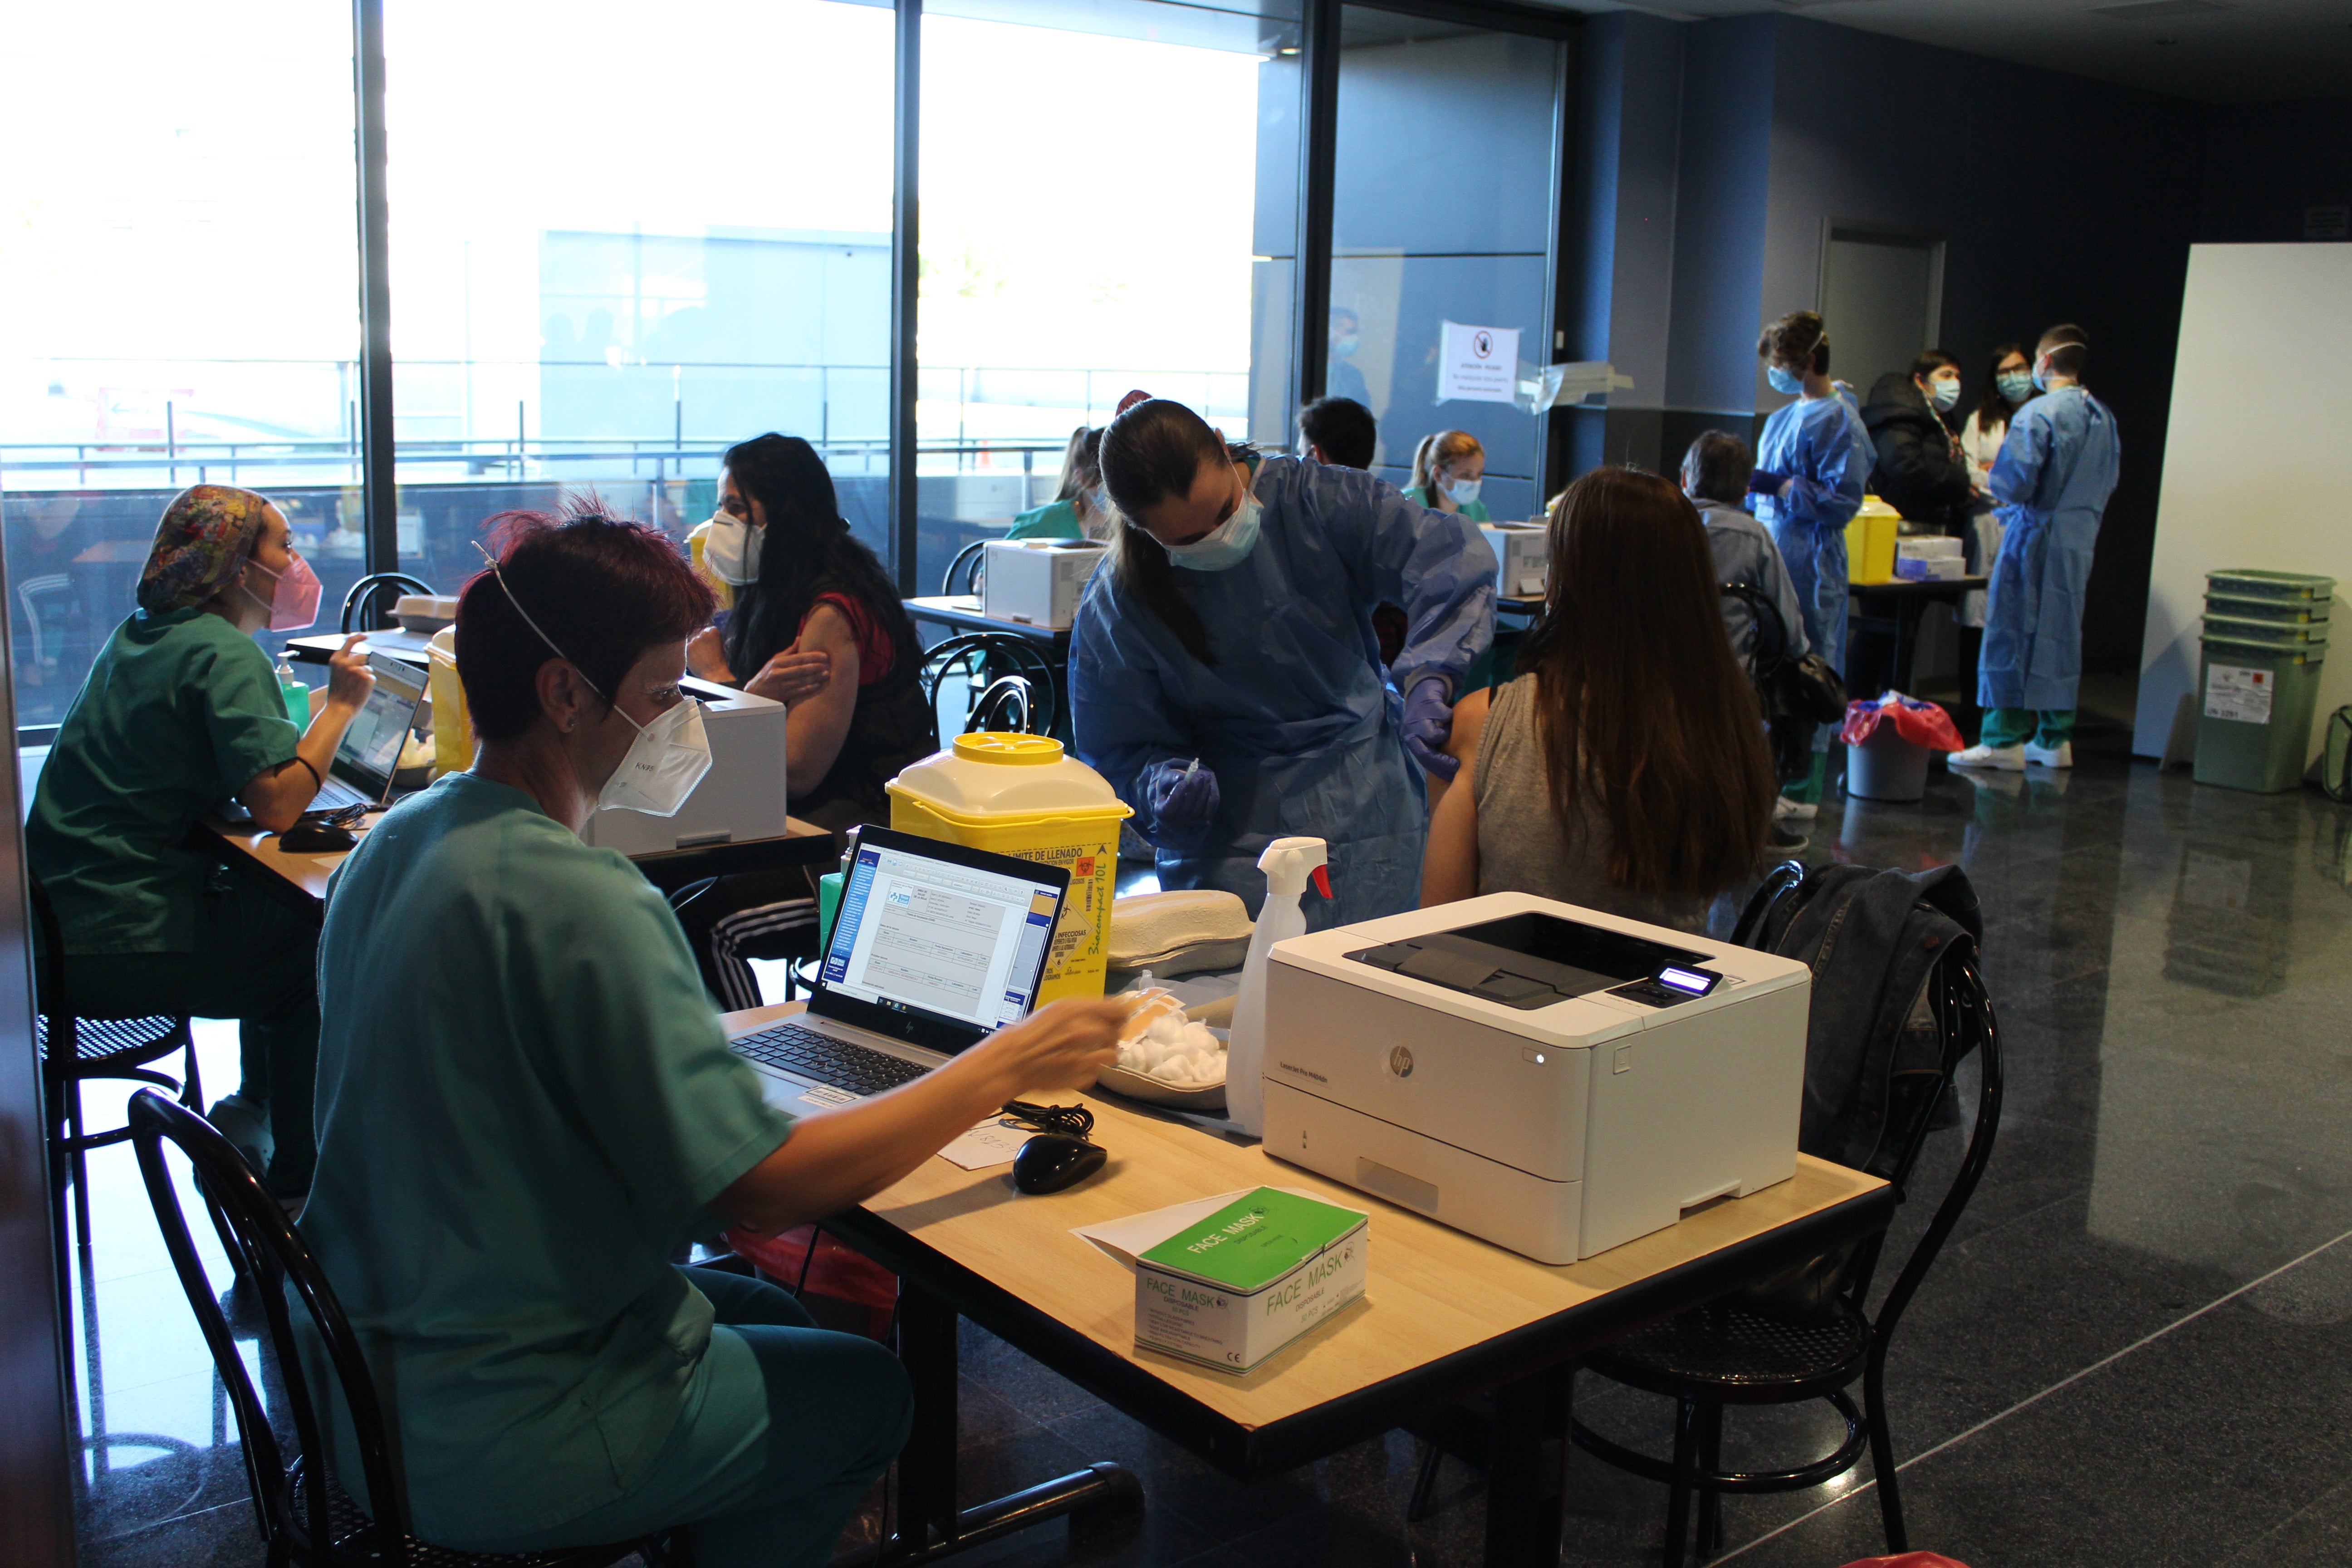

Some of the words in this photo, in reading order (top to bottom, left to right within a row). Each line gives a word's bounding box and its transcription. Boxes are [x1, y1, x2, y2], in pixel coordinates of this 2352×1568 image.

[635, 762, 654, 771] KN95
[1035, 851, 1044, 861] DE
[1047, 848, 1083, 860] LLENADO
[1095, 863, 1106, 882] 10L
[1088, 886, 1106, 955] Biocompact
[1058, 930, 1086, 938] INFECCIOSAS
[1280, 1061, 1299, 1073] LaserJet
[1300, 1068, 1308, 1077] Pro
[1392, 1046, 1412, 1078] hp
[1187, 1234, 1228, 1254] FACE
[1222, 1213, 1264, 1235] MASK
[1267, 1279, 1302, 1316] FACE
[1308, 1250, 1343, 1289] MASK
[1147, 1278, 1176, 1298] FACE
[1181, 1288, 1215, 1308] MASK
[1296, 1287, 1325, 1312] DISPOSABLE
[1164, 1296, 1199, 1311] DISPOSABLE
[1227, 1352, 1240, 1363] CE
